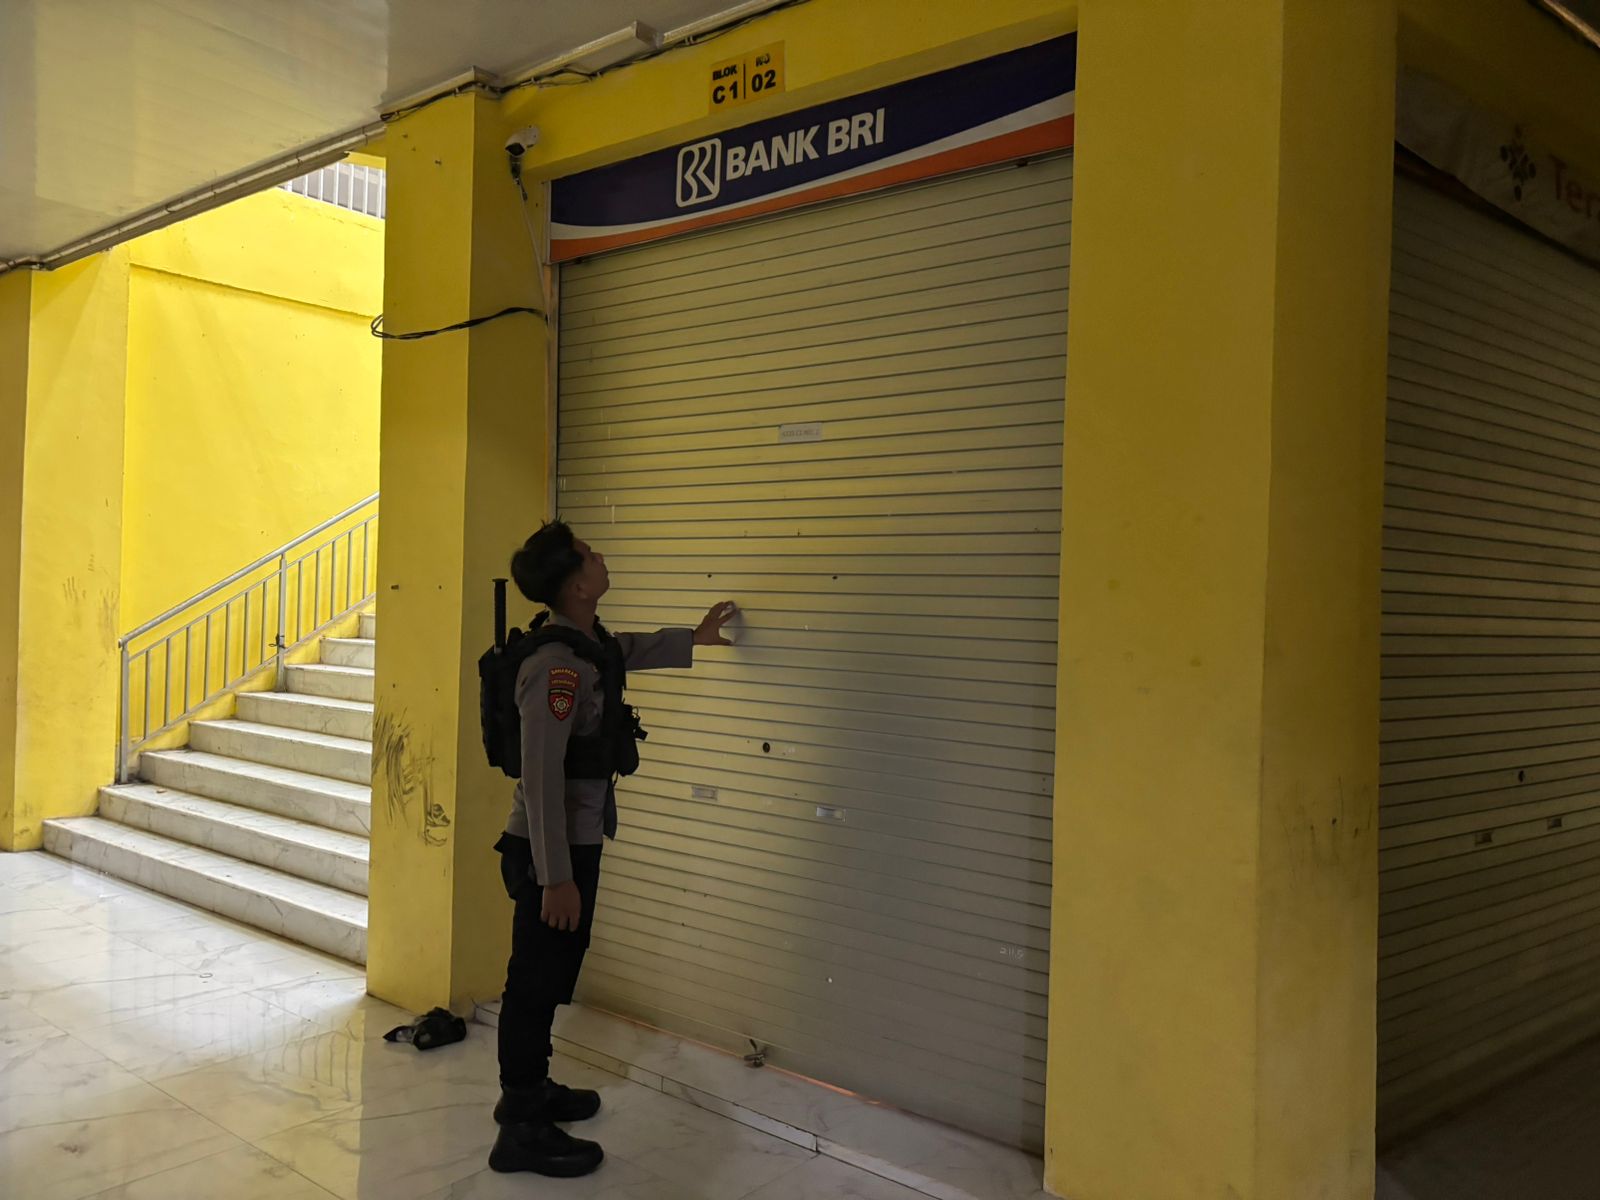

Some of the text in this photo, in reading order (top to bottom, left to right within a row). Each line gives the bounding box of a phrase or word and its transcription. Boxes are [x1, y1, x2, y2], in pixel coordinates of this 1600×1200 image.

[712, 64, 737, 80] BLOK
[751, 69, 776, 92] 02
[726, 125, 821, 181] BANK
[828, 108, 885, 155] BRI
[1547, 153, 1600, 222] Ter
